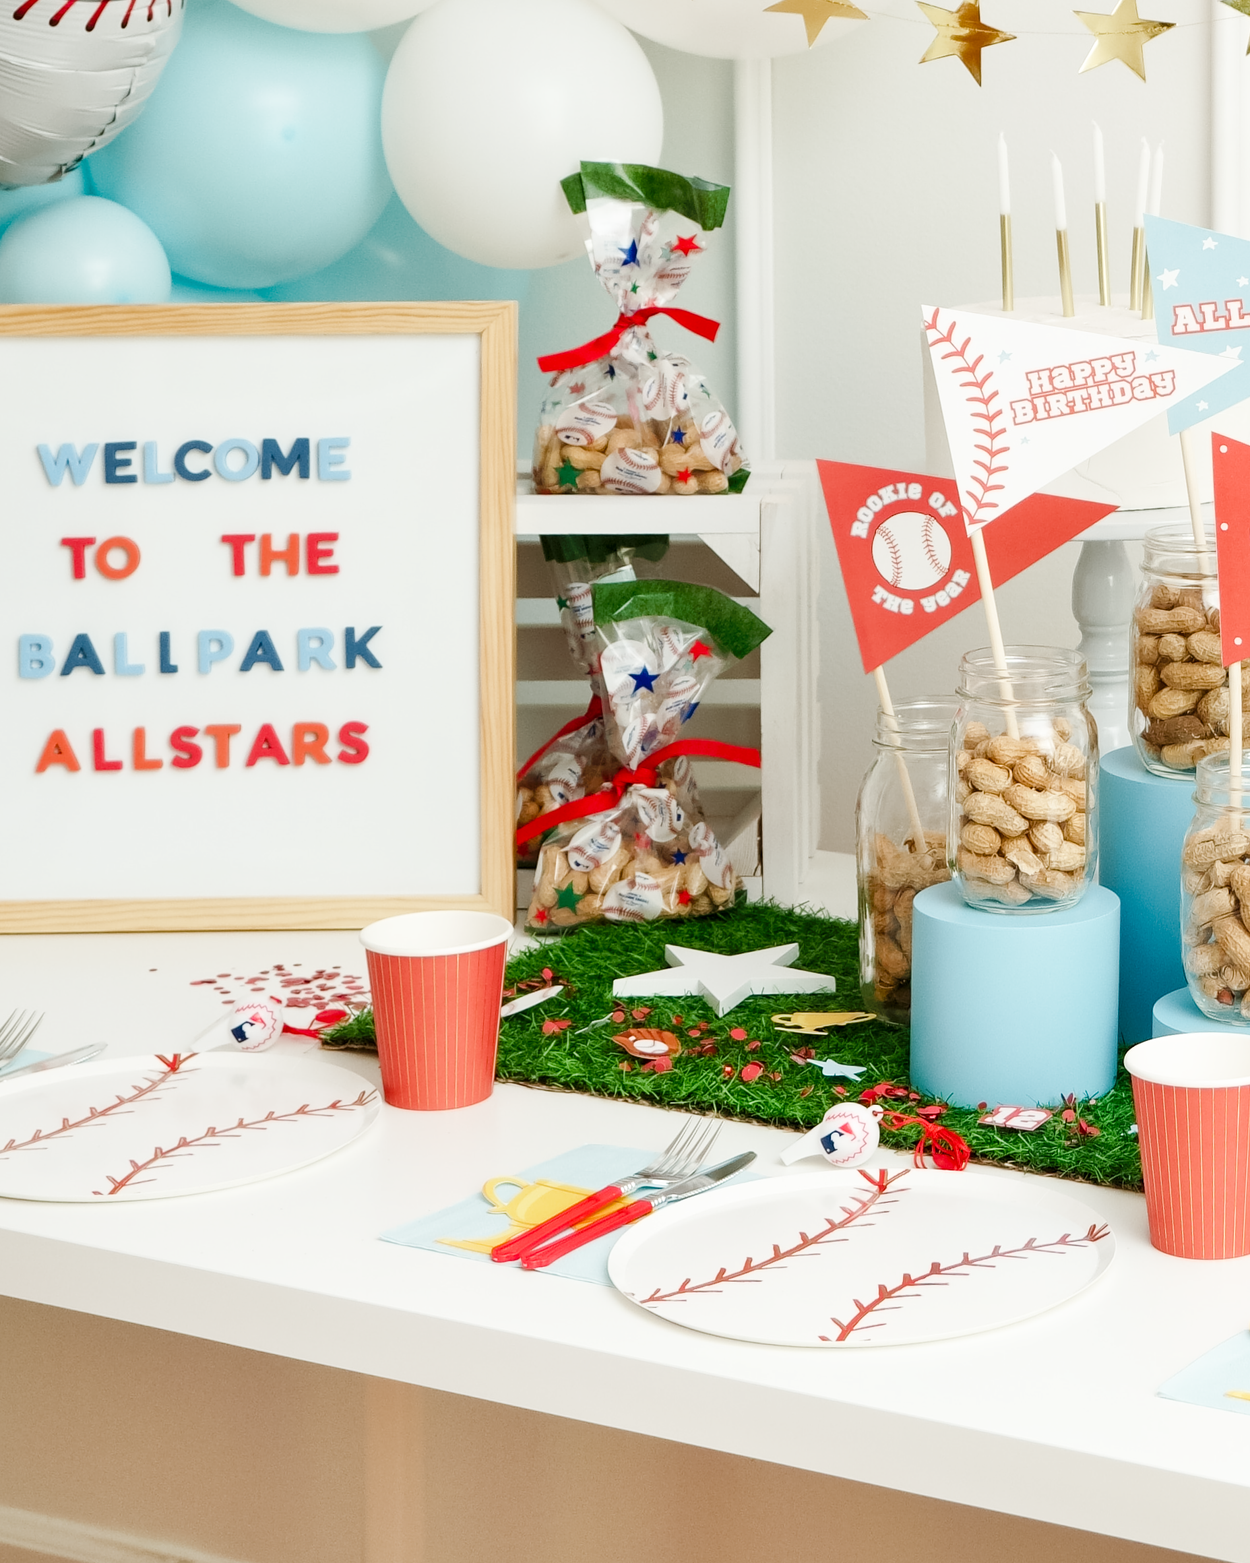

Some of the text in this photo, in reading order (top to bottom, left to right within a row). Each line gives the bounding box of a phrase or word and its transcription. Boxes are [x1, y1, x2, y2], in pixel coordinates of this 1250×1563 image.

[37, 437, 352, 487] WELCOME
[928, 491, 958, 518] OF
[60, 532, 340, 580] TO THE
[35, 721, 370, 774] ALLSTARS
[984, 1106, 1047, 1129] 12
